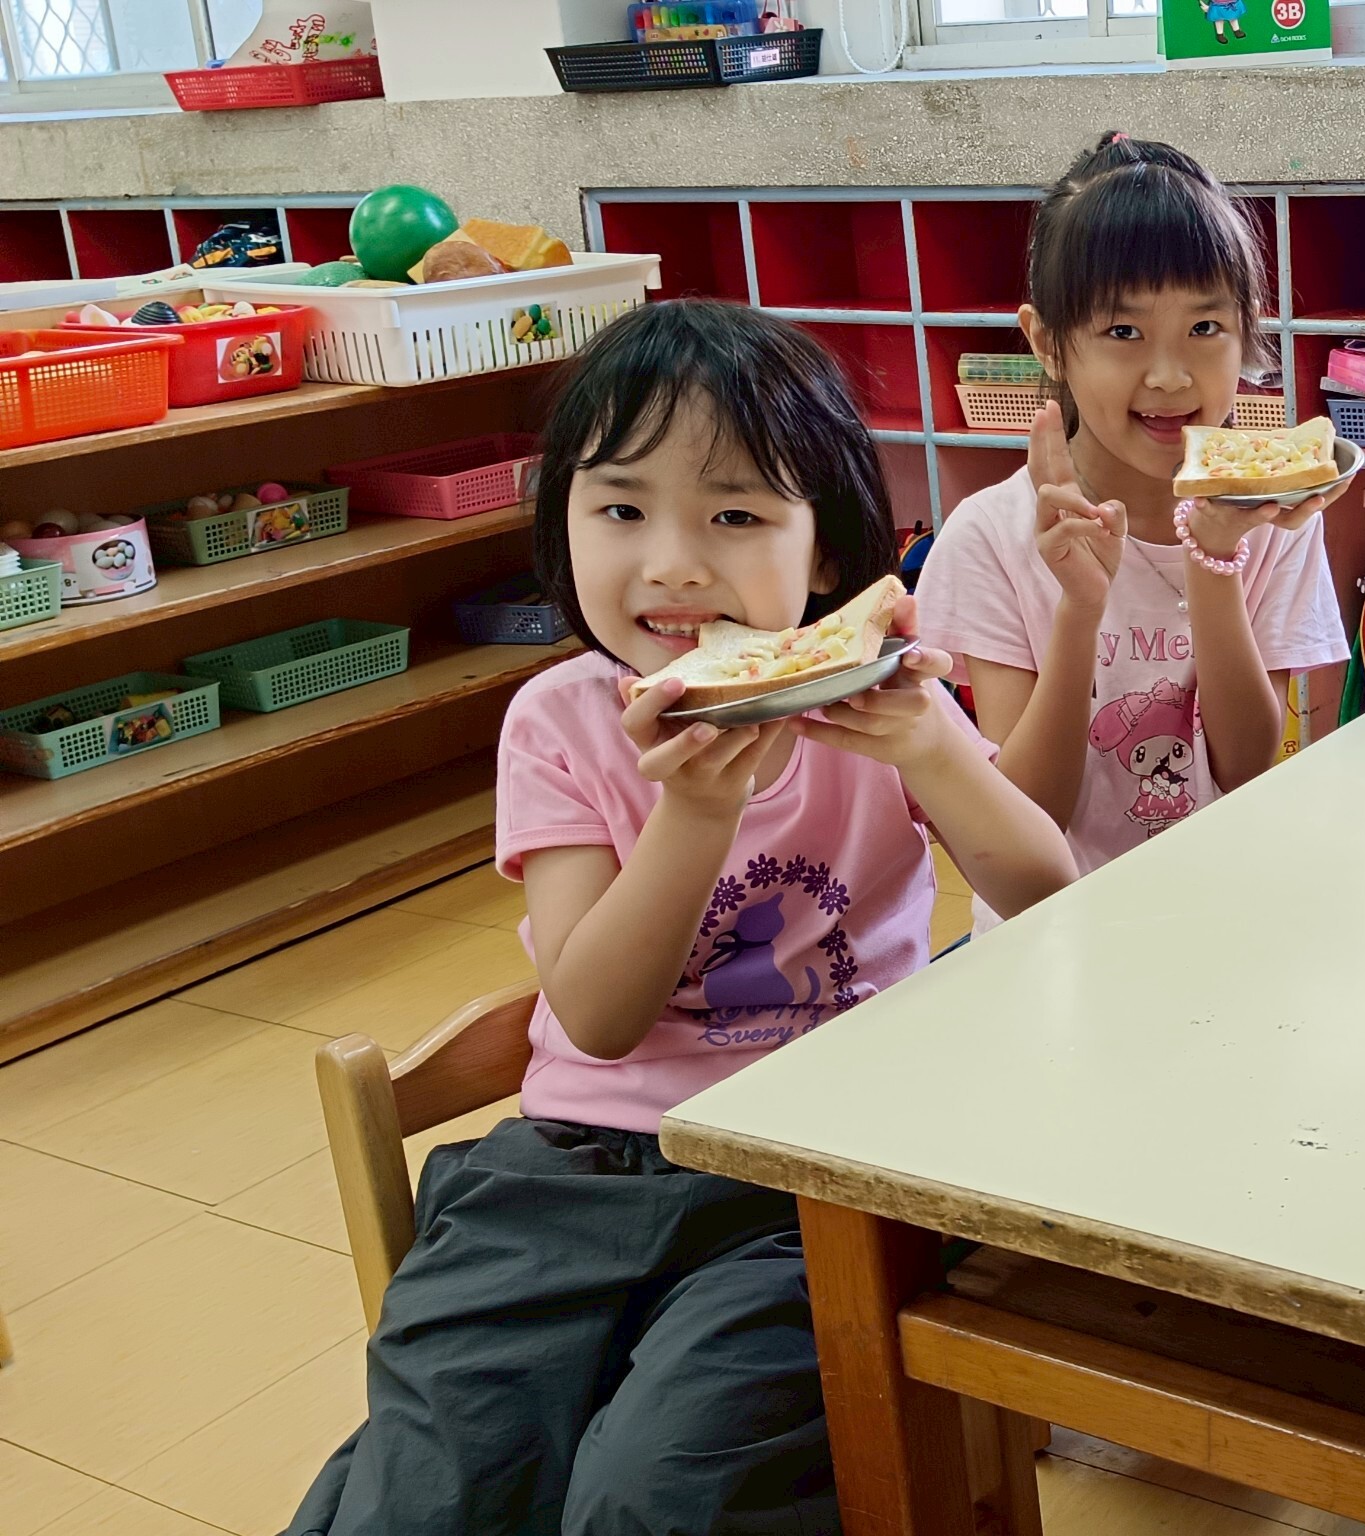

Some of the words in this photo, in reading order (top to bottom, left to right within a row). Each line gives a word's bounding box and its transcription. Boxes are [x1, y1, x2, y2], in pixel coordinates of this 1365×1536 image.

[1276, 2, 1301, 20] 3B
[1097, 631, 1121, 667] y
[1129, 624, 1195, 662] Me
[700, 1020, 795, 1049] Every
